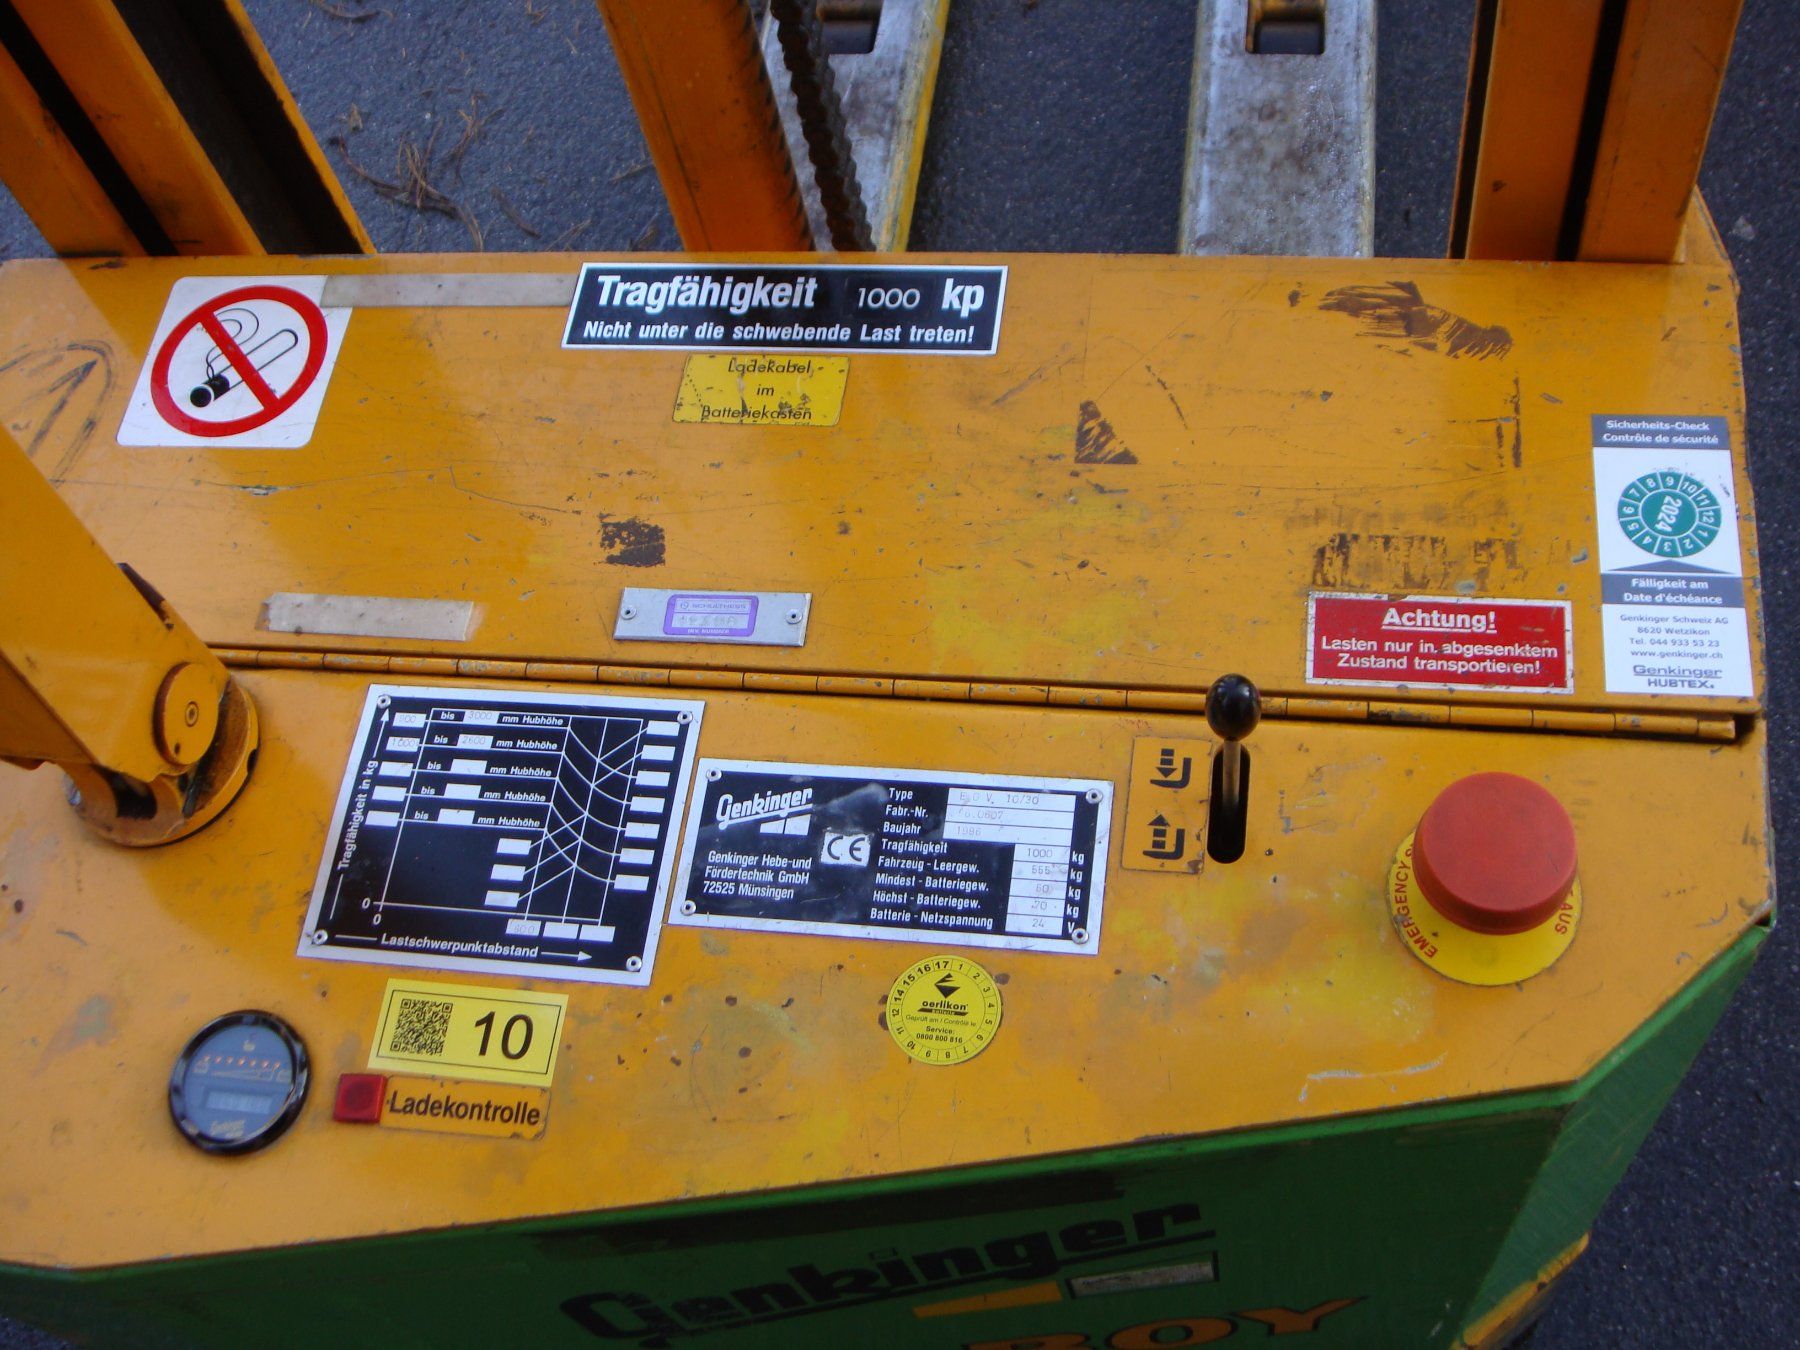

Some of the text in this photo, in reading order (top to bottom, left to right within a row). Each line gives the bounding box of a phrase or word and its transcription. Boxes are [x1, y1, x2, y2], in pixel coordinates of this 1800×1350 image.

[598, 275, 984, 318] Tragfähigkeit 1000 kp
[583, 321, 974, 343] Nicht unter die schwebende Last treten!
[728, 358, 811, 375] Ladekabel
[756, 383, 775, 397] im
[701, 405, 812, 419] Batteriekasten
[1606, 420, 1709, 431] Sicherheits-Check
[1603, 432, 1719, 444] Contrôle de sécurité
[1646, 478, 1656, 488] 8
[1666, 476, 1674, 486] 9
[1682, 481, 1697, 494] 10
[1628, 487, 1640, 497] 7
[1697, 494, 1710, 506] 11
[1654, 495, 1682, 531] 2024
[1631, 578, 1708, 590] Fälligkeit am
[1624, 592, 1722, 604] Date d'échéance
[1382, 608, 1496, 633] Achtung!
[1620, 614, 1729, 625] Genkinger Schweiz AG
[1638, 626, 1710, 635] 8620 Wetzikon
[1321, 636, 1378, 651] Lasten
[1384, 641, 1413, 652] nur
[1442, 640, 1558, 658] abgesenktem
[1629, 637, 1647, 645] Tel.
[1650, 638, 1668, 646] 044
[1671, 639, 1689, 647] 933
[1693, 639, 1705, 647] 53
[1631, 650, 1723, 659] www.genkinger.ch
[1337, 653, 1540, 674] Zustand transportieren!
[1633, 665, 1722, 679] Genkinger
[440, 711, 455, 720] bis
[502, 715, 519, 724] mm
[522, 715, 563, 726] Hubhöhe
[433, 735, 448, 744] bis
[496, 739, 513, 748] mm
[516, 738, 558, 750] Hubhöhe
[427, 760, 552, 777] bis mm Hubhöhe
[420, 785, 546, 802] bis mm Hubhöhe
[889, 787, 913, 801] Type
[337, 760, 378, 870] Tragfähigkeit in kg
[716, 788, 813, 831] Genkinger
[885, 804, 928, 818] Fabr.-Nr.
[414, 810, 540, 828] bis mm Hubhöhe
[883, 821, 921, 836] Baujahr
[881, 838, 1085, 865] Tragfähigkeit 1000 kg
[708, 850, 812, 870] Genkinger Hebe-und
[704, 865, 810, 885] Fördertechnik GmbH
[878, 855, 924, 872] Fahrzeug
[933, 859, 980, 874] Leergew.
[1070, 868, 1083, 883] kg
[703, 881, 795, 900] 72525 Münsingen
[875, 872, 916, 886] Mindest
[925, 876, 989, 892] Batteriegew.
[1068, 885, 1081, 900] kg
[361, 897, 371, 910] 0
[872, 890, 907, 904] Höchst
[916, 893, 981, 909] Batteriegew.
[1066, 903, 1079, 918] kg
[372, 913, 382, 925] 0
[870, 907, 911, 922] Batterie
[920, 911, 994, 930] Netzspannung
[1032, 918, 1044, 928] 24
[1067, 921, 1075, 933] V
[381, 932, 539, 957] Lastschwerpunktabstand
[917, 964, 932, 975] 16
[935, 961, 949, 969] 17
[902, 974, 916, 986] 15
[972, 972, 981, 980] 2
[894, 989, 905, 1002] 14
[892, 1008, 900, 1017] 12
[922, 1000, 966, 1011] oerlikon
[474, 1011, 534, 1060] 10
[389, 1090, 541, 1126] Ladekontrolle
[559, 1203, 1201, 1348] Genkinger
